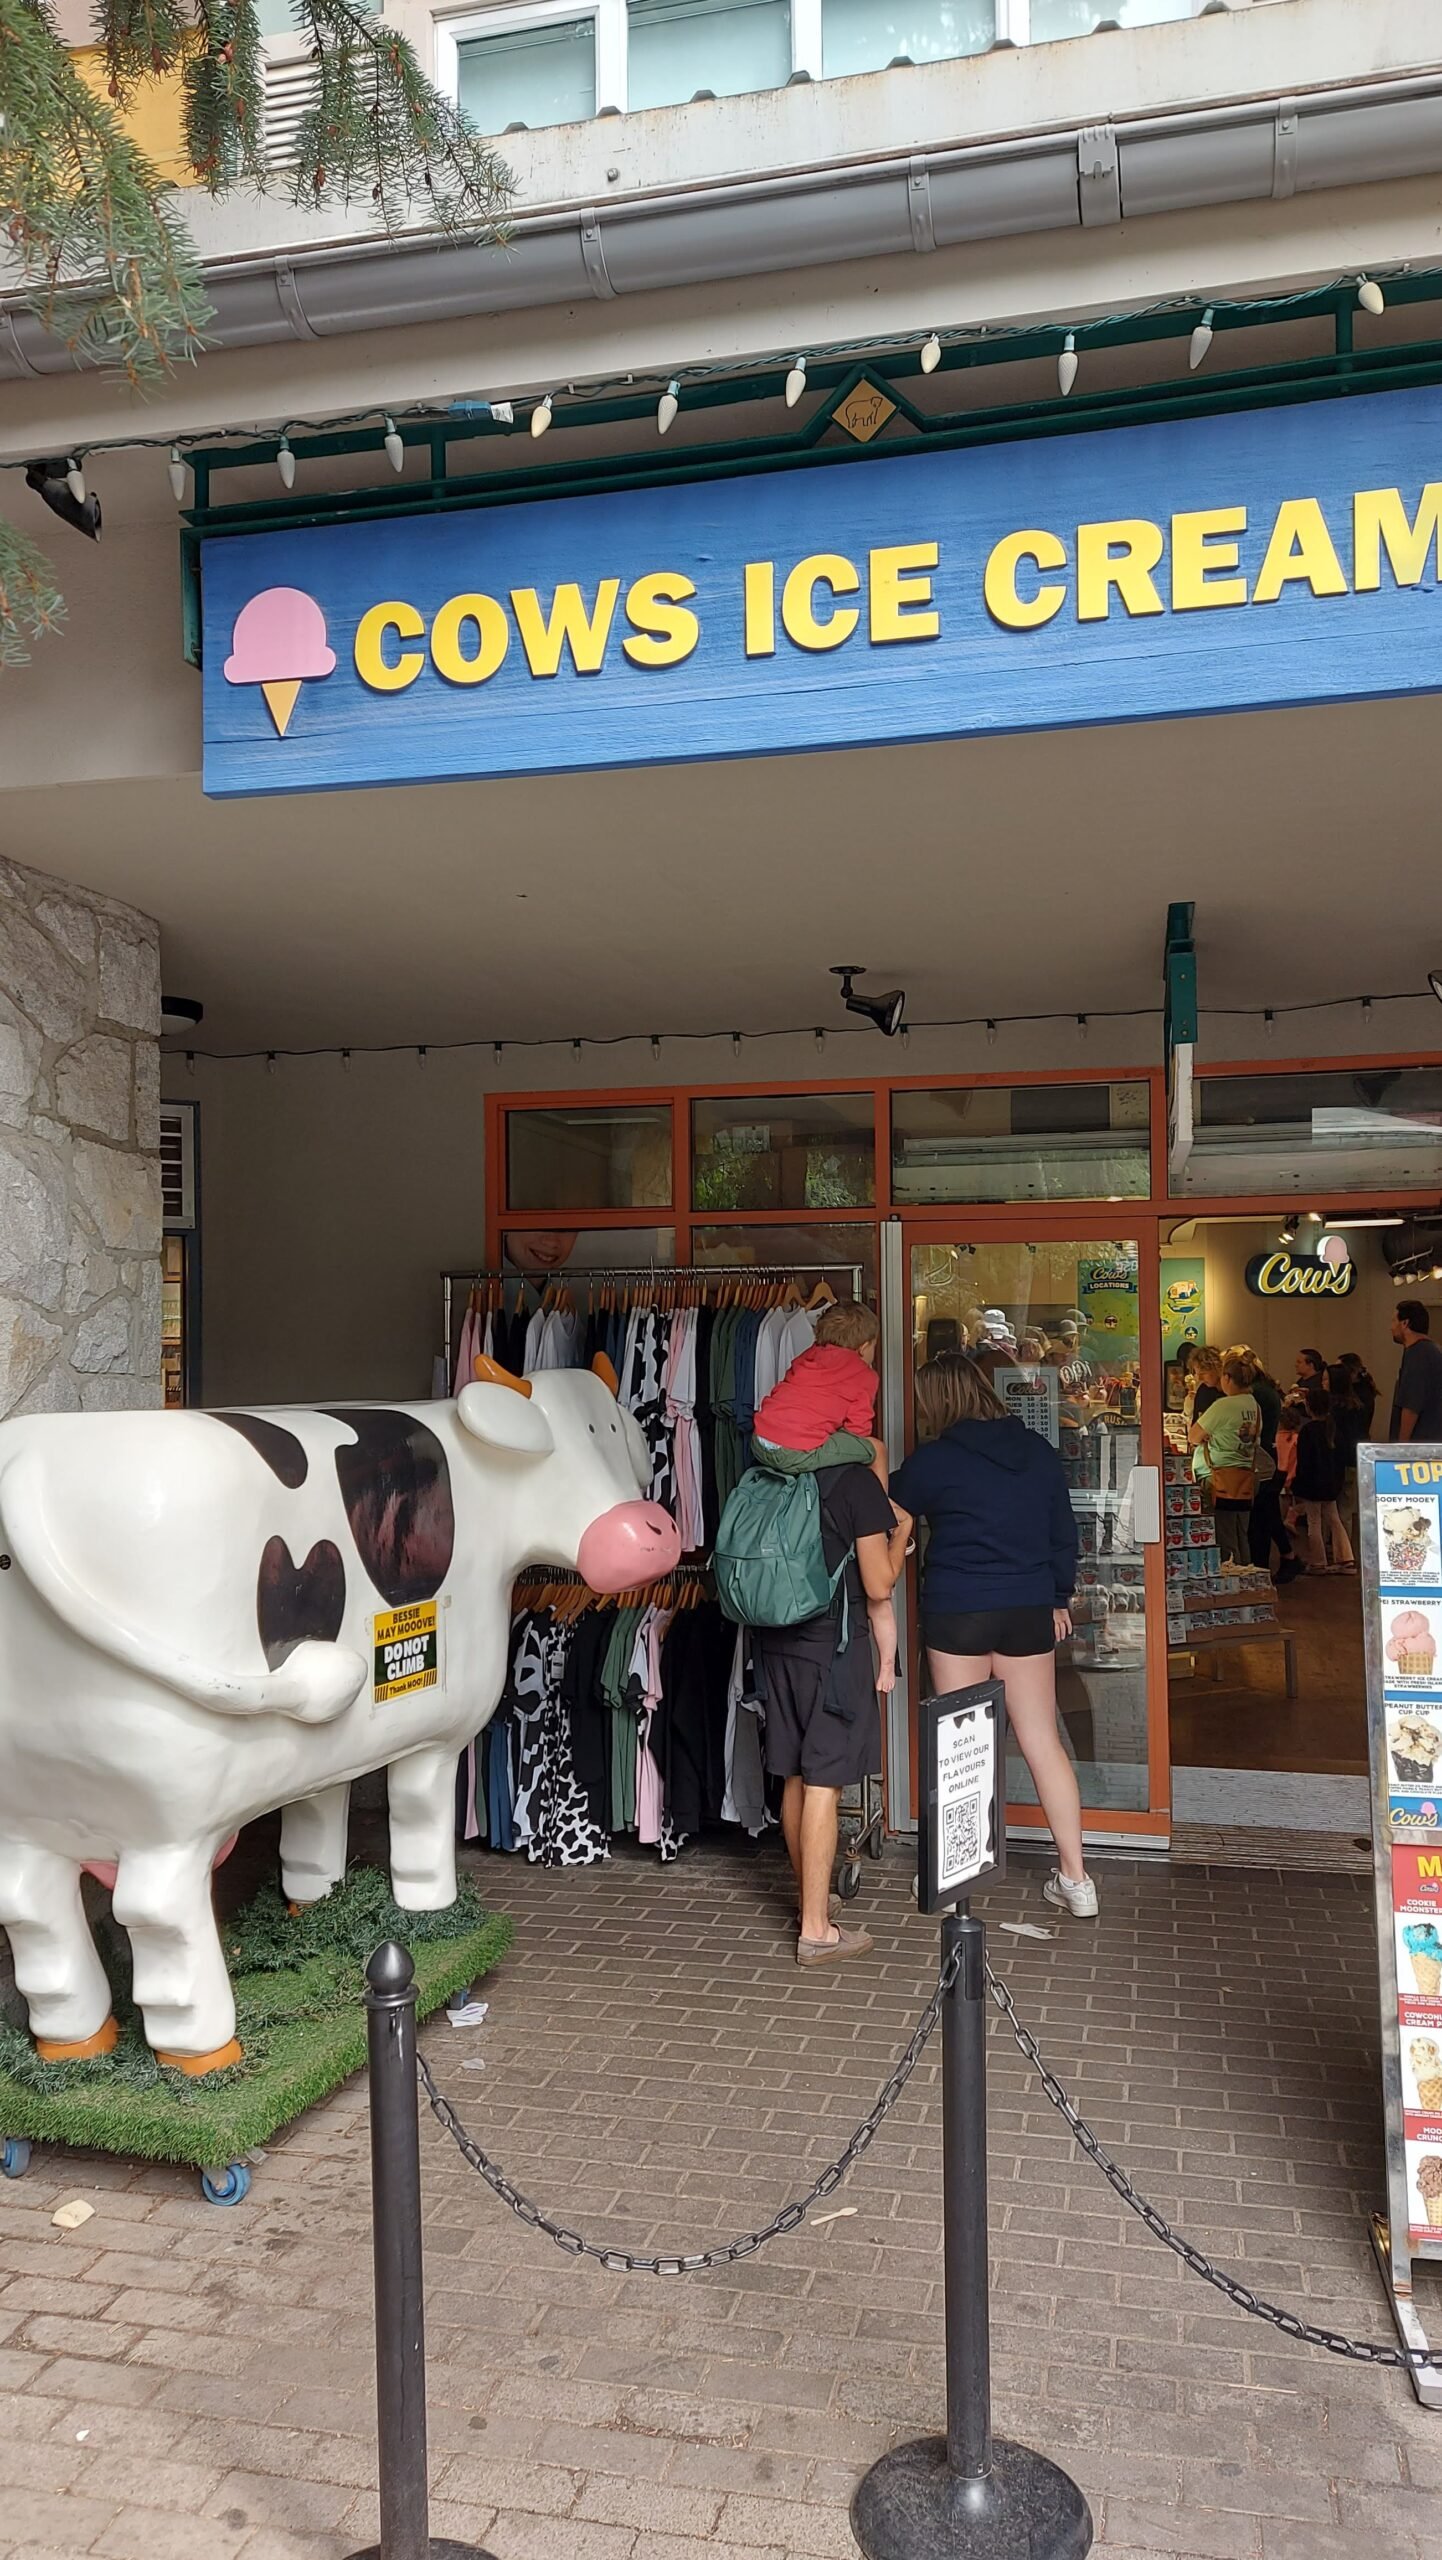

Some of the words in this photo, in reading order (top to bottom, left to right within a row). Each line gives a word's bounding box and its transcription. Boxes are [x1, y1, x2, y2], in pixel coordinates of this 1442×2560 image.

[354, 571, 699, 694] COWS
[745, 541, 941, 657] ICE
[984, 482, 1442, 632] CREAM
[393, 1608, 420, 1624] BESSIE
[377, 1625, 397, 1641] MAY
[397, 1616, 435, 1635] MOOOVE!
[384, 1643, 403, 1664] DO
[403, 1634, 430, 1657] NOT
[387, 1654, 425, 1681] CLIMB
[389, 1681, 407, 1695] Thank
[952, 1734, 976, 1749] SCAN
[938, 1757, 950, 1768] TO
[950, 1750, 973, 1765] VIEW
[973, 1743, 990, 1757] OUR
[942, 1758, 986, 1782] FLAVOURS
[948, 1774, 980, 1794] ONLINE
[1407, 1899, 1437, 1907] COOKIE
[1405, 2019, 1435, 2027] CREAM
